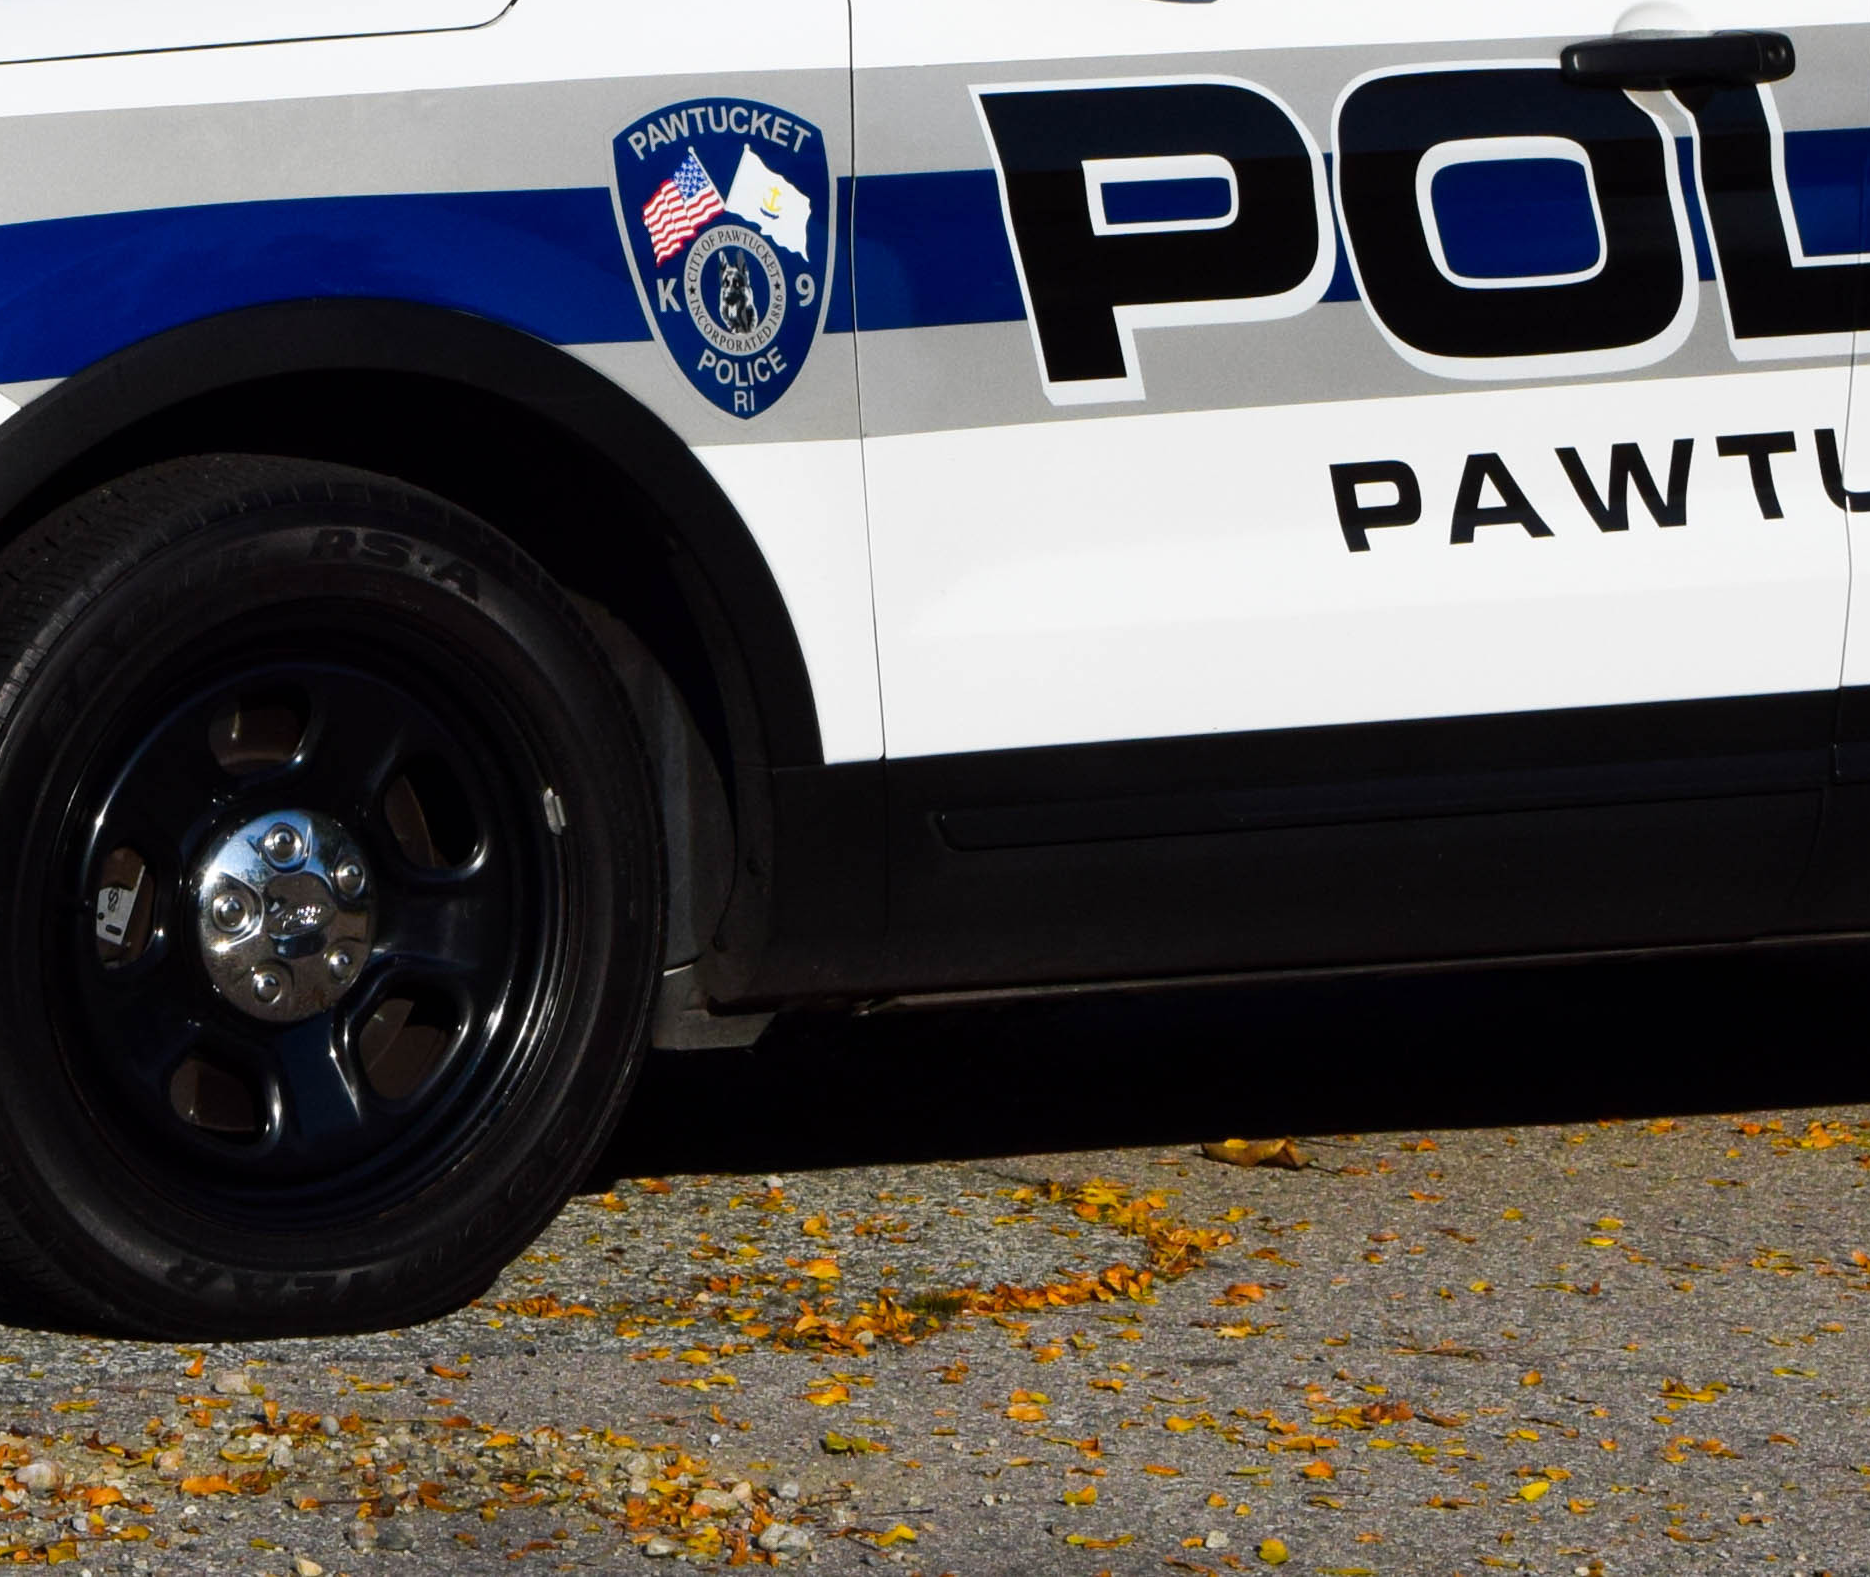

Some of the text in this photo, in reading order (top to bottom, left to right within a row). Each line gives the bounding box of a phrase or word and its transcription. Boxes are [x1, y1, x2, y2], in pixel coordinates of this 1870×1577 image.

[627, 105, 812, 161] PAWTUCKET
[687, 229, 781, 283] CITY OF PAWTUCKET
[656, 273, 815, 313] K 9
[690, 298, 773, 352] INCORPORATED
[697, 345, 788, 387] POLICE
[733, 389, 755, 412] RI
